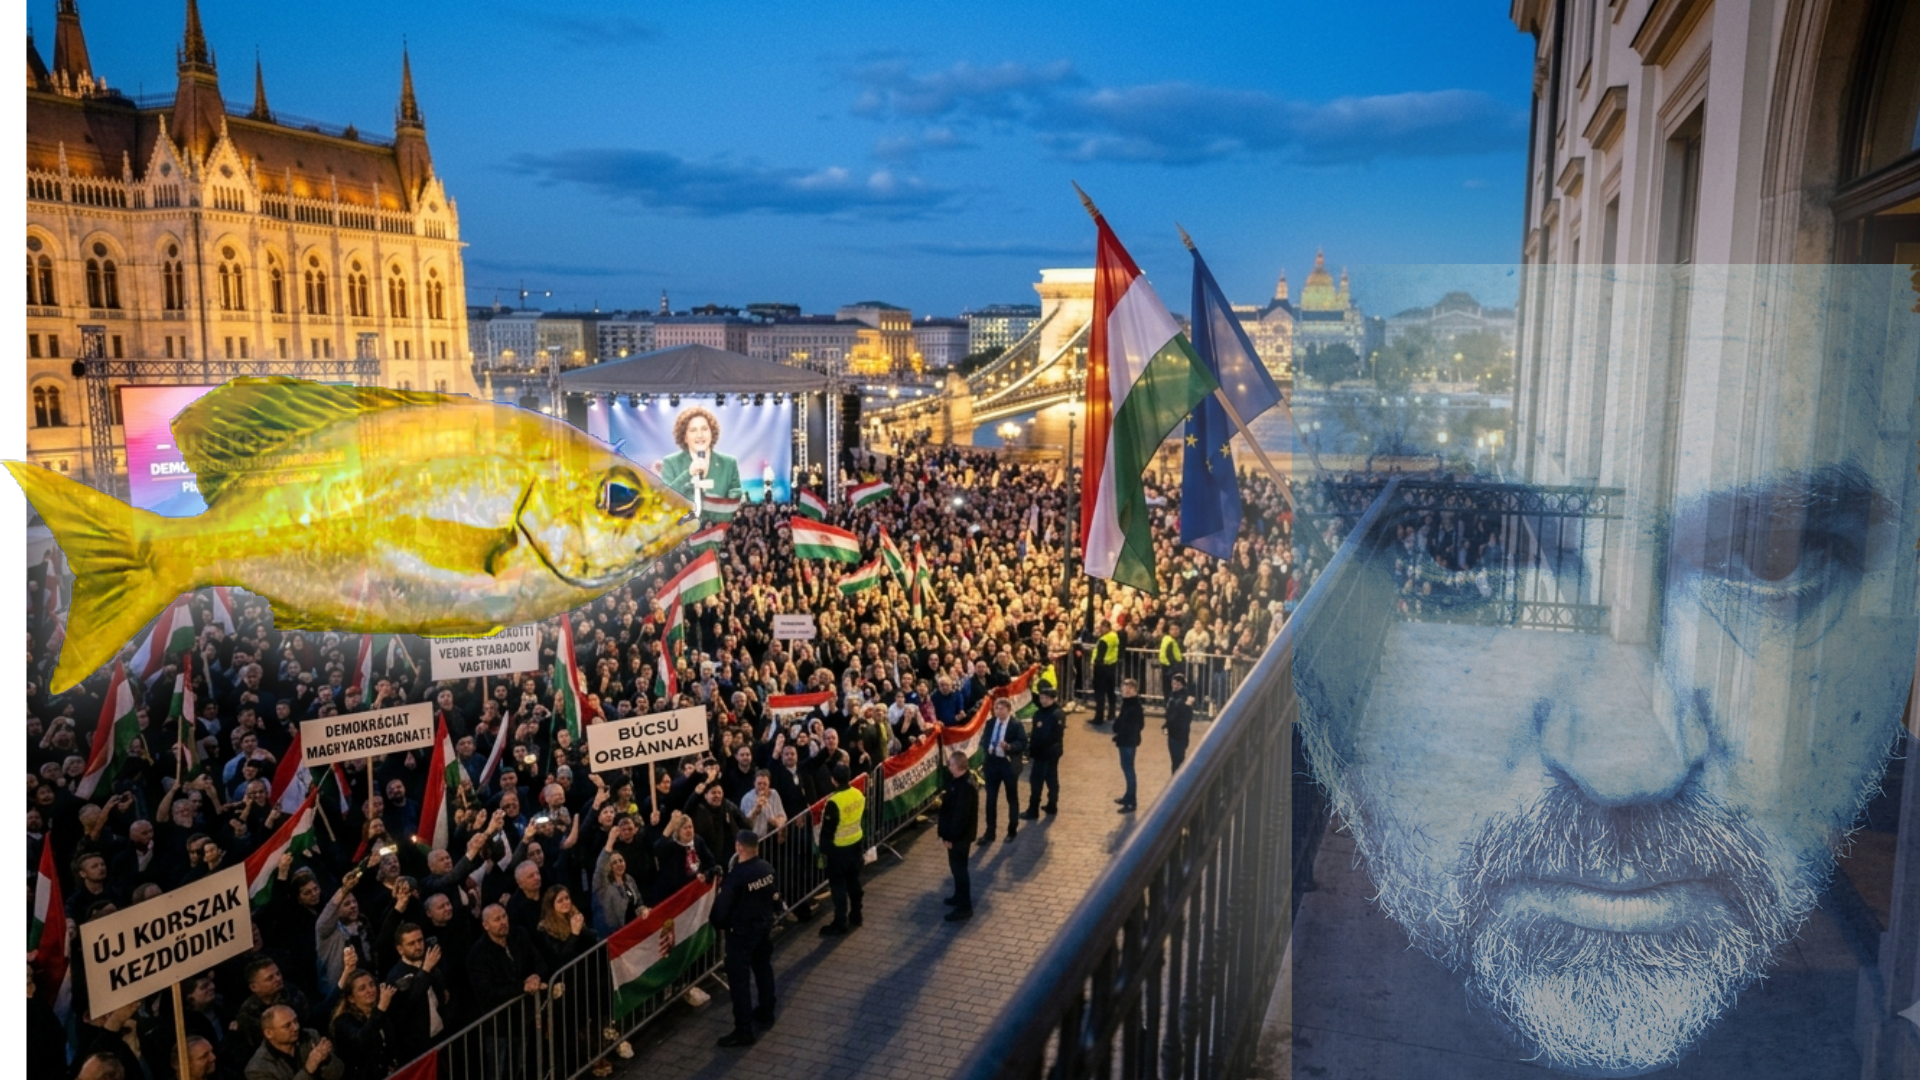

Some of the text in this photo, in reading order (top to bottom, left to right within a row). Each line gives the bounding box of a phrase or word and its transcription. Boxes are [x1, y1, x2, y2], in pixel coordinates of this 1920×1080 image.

[594, 733, 704, 764] ORBÁNNAK!
[618, 713, 679, 740] BÚCSÚ
[93, 885, 241, 964] ÚJ KORSZAK
[109, 918, 236, 992] KEZDŐDIK!
